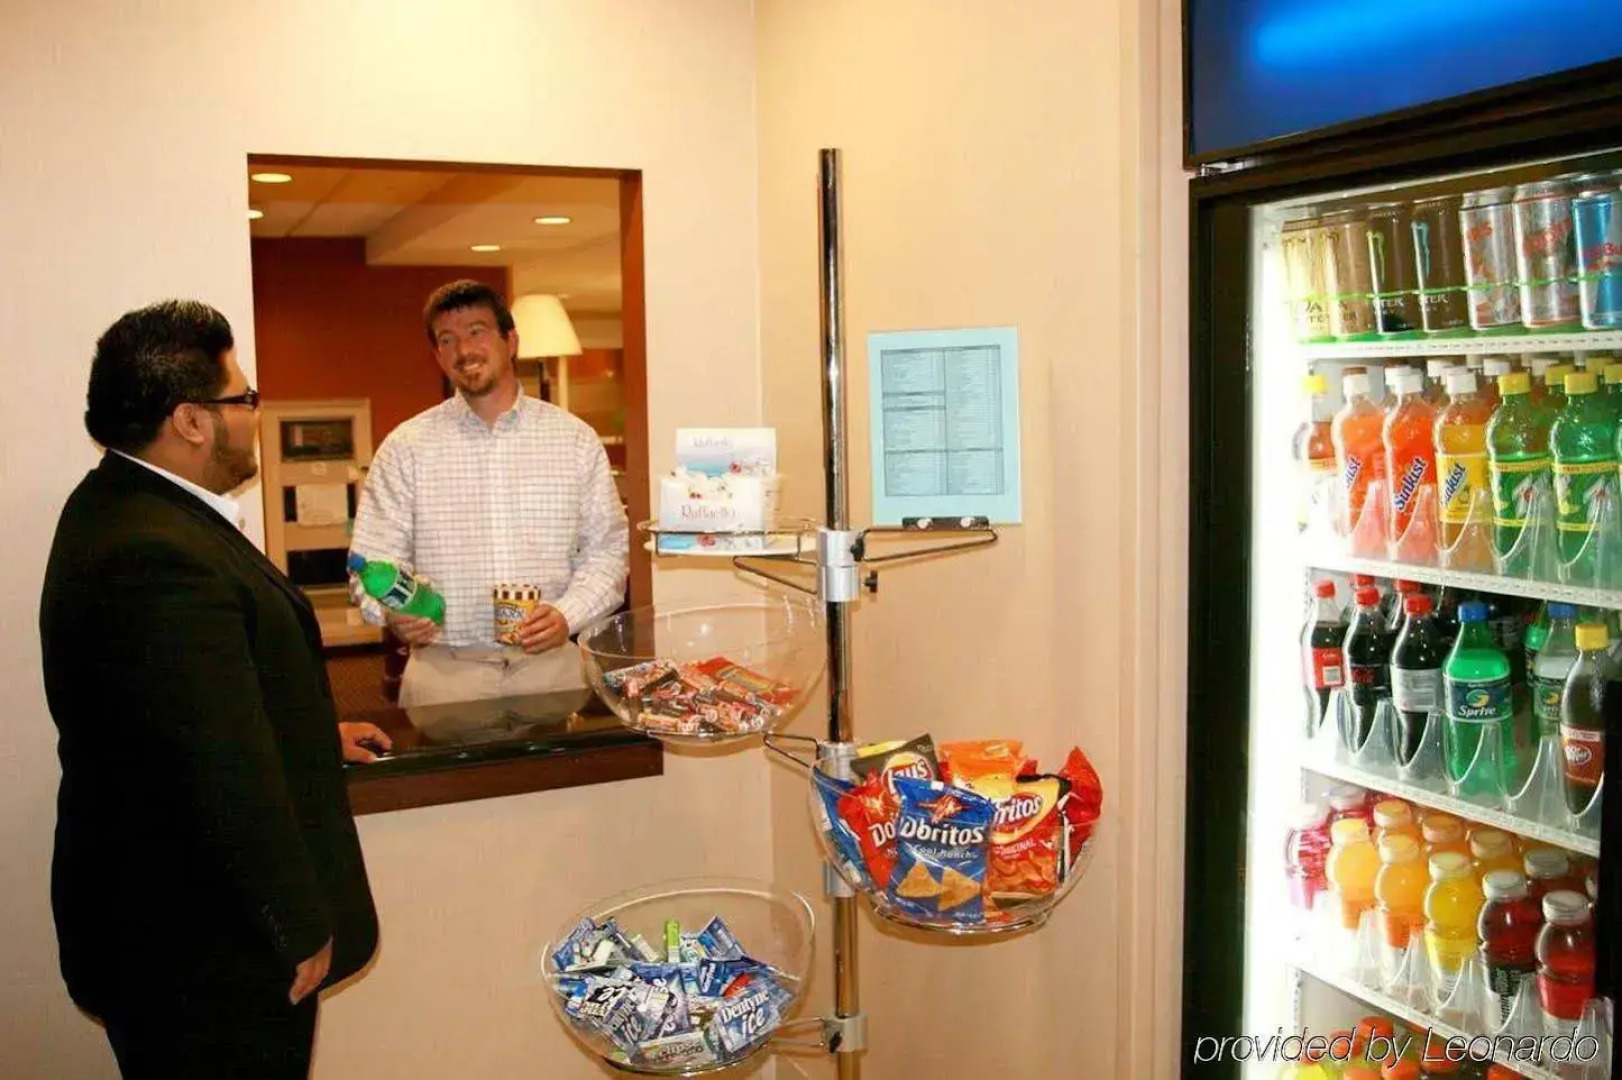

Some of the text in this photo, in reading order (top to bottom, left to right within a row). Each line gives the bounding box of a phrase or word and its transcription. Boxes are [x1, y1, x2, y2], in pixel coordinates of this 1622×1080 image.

[1394, 457, 1427, 512] Sunkist
[1458, 705, 1497, 718] Sprite
[899, 815, 985, 847] Doritos
[721, 988, 770, 1023] Dentyne
[741, 1007, 766, 1039] ice
